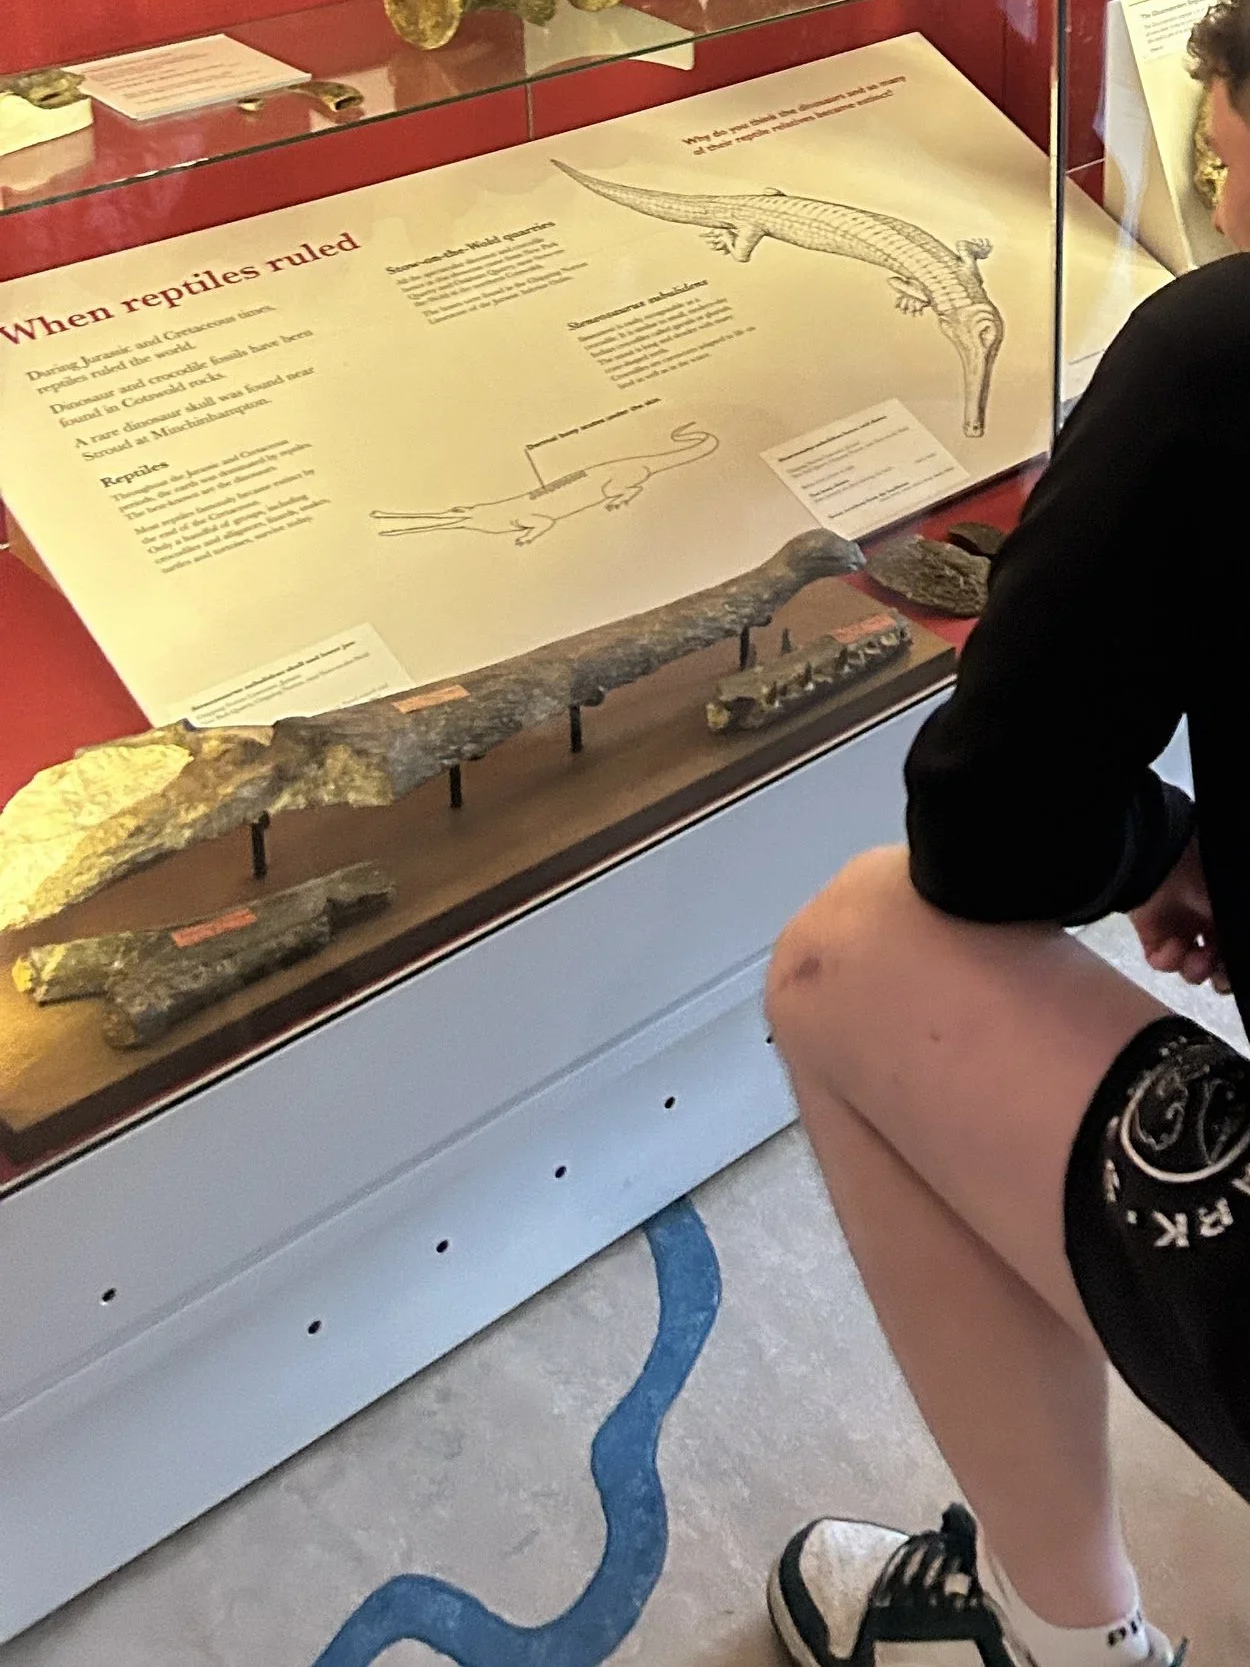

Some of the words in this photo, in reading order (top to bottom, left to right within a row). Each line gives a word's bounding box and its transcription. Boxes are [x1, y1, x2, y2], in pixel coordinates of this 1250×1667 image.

[0, 307, 116, 346] When
[120, 266, 261, 314] reptiles
[265, 232, 361, 273] ruled
[25, 361, 82, 382] During
[79, 345, 133, 369] Jurassic
[135, 335, 164, 350] and
[162, 315, 237, 341] Cretaceous
[237, 305, 277, 320] times,
[36, 374, 89, 395] reptiles
[89, 360, 128, 379] ruled
[128, 355, 153, 367] the
[153, 340, 197, 359] world.
[49, 390, 115, 415] Dinosaur
[118, 378, 147, 394] and
[147, 361, 209, 385] crocodile
[209, 349, 249, 366] fossils
[247, 340, 280, 354] have
[279, 329, 314, 343] been
[58, 407, 104, 429] found
[103, 405, 121, 414] in
[121, 381, 187, 408] Cotswold
[188, 372, 227, 389] rocks.
[81, 438, 134, 462] Stroud
[135, 435, 151, 446] at
[149, 398, 273, 440] Minchinhampton.
[89, 429, 120, 443] rare
[122, 408, 182, 433] dinosaur
[184, 396, 217, 413] skull
[217, 390, 245, 402] was
[243, 374, 286, 394] found
[285, 367, 315, 381] near
[99, 461, 170, 488] Reptiles
